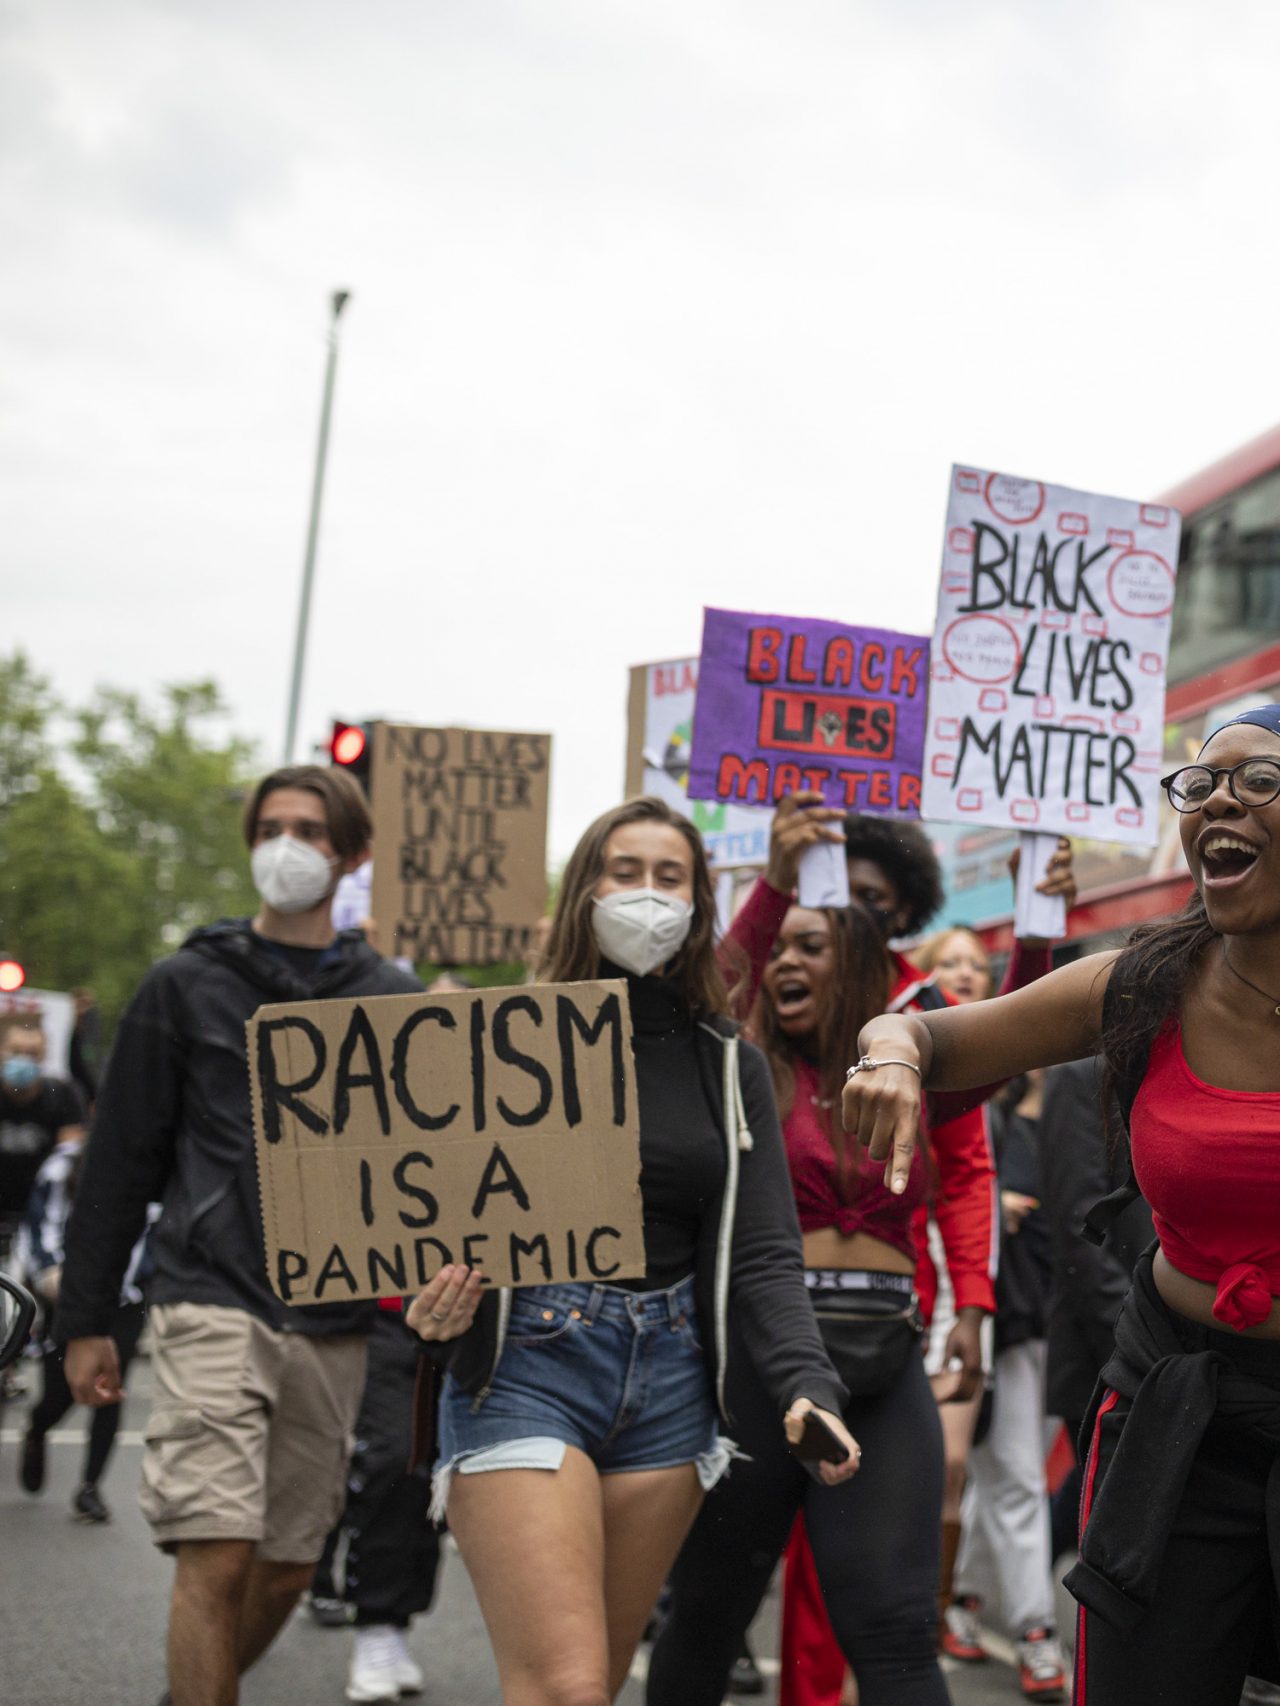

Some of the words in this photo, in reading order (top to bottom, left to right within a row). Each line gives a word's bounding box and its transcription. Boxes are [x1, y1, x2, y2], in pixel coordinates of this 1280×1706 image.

[957, 518, 1113, 618] BLACK
[746, 626, 922, 698] BLACK
[1013, 622, 1134, 712] LIVES
[386, 728, 448, 768] NO
[463, 733, 547, 772] LIVES
[717, 752, 923, 810] MATTER
[951, 715, 1144, 809] MATTER
[257, 993, 626, 1145] RACISM
[360, 1151, 439, 1229] IS
[472, 1142, 531, 1219] A
[278, 1226, 622, 1301] PANDEMIC
